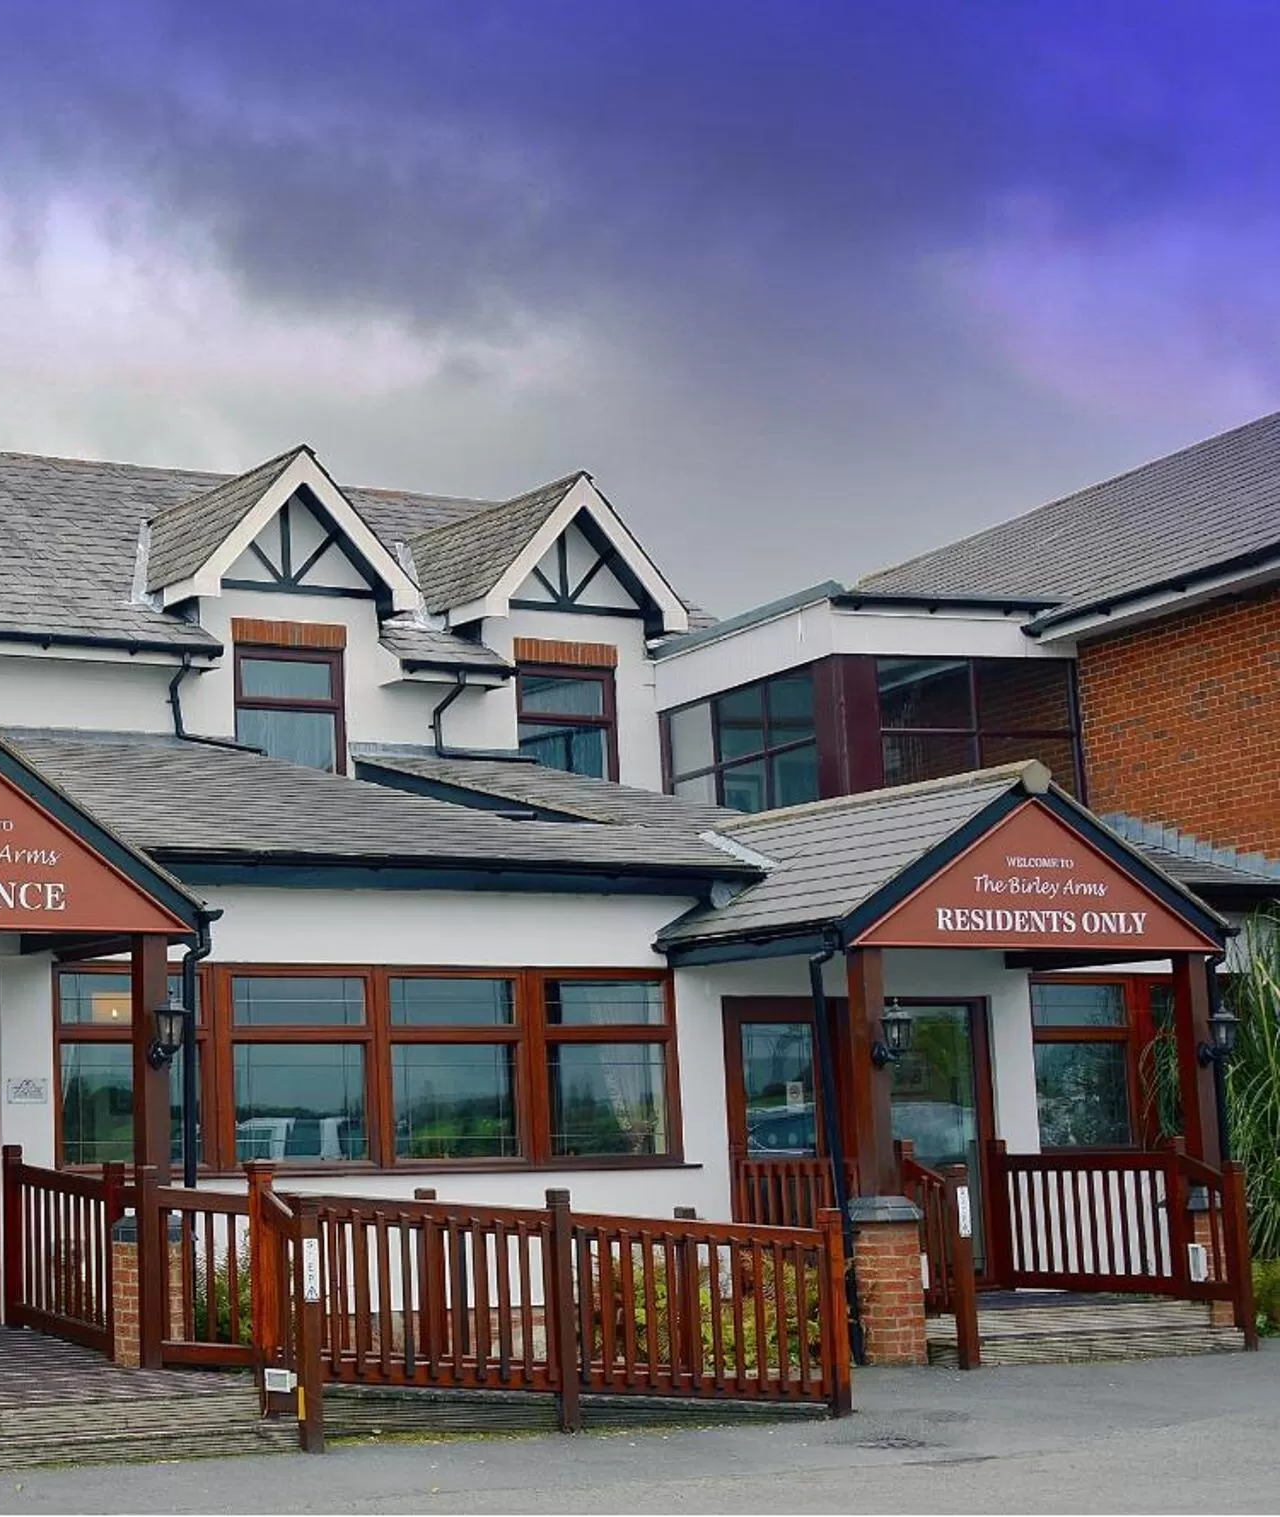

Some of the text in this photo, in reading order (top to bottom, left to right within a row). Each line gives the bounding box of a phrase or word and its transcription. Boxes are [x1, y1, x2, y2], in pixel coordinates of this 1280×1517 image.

[1006, 856, 1074, 868] WELCOME TO
[973, 874, 1109, 899] The Birley Arms
[936, 907, 1147, 935] RESIDENTS ONLY
